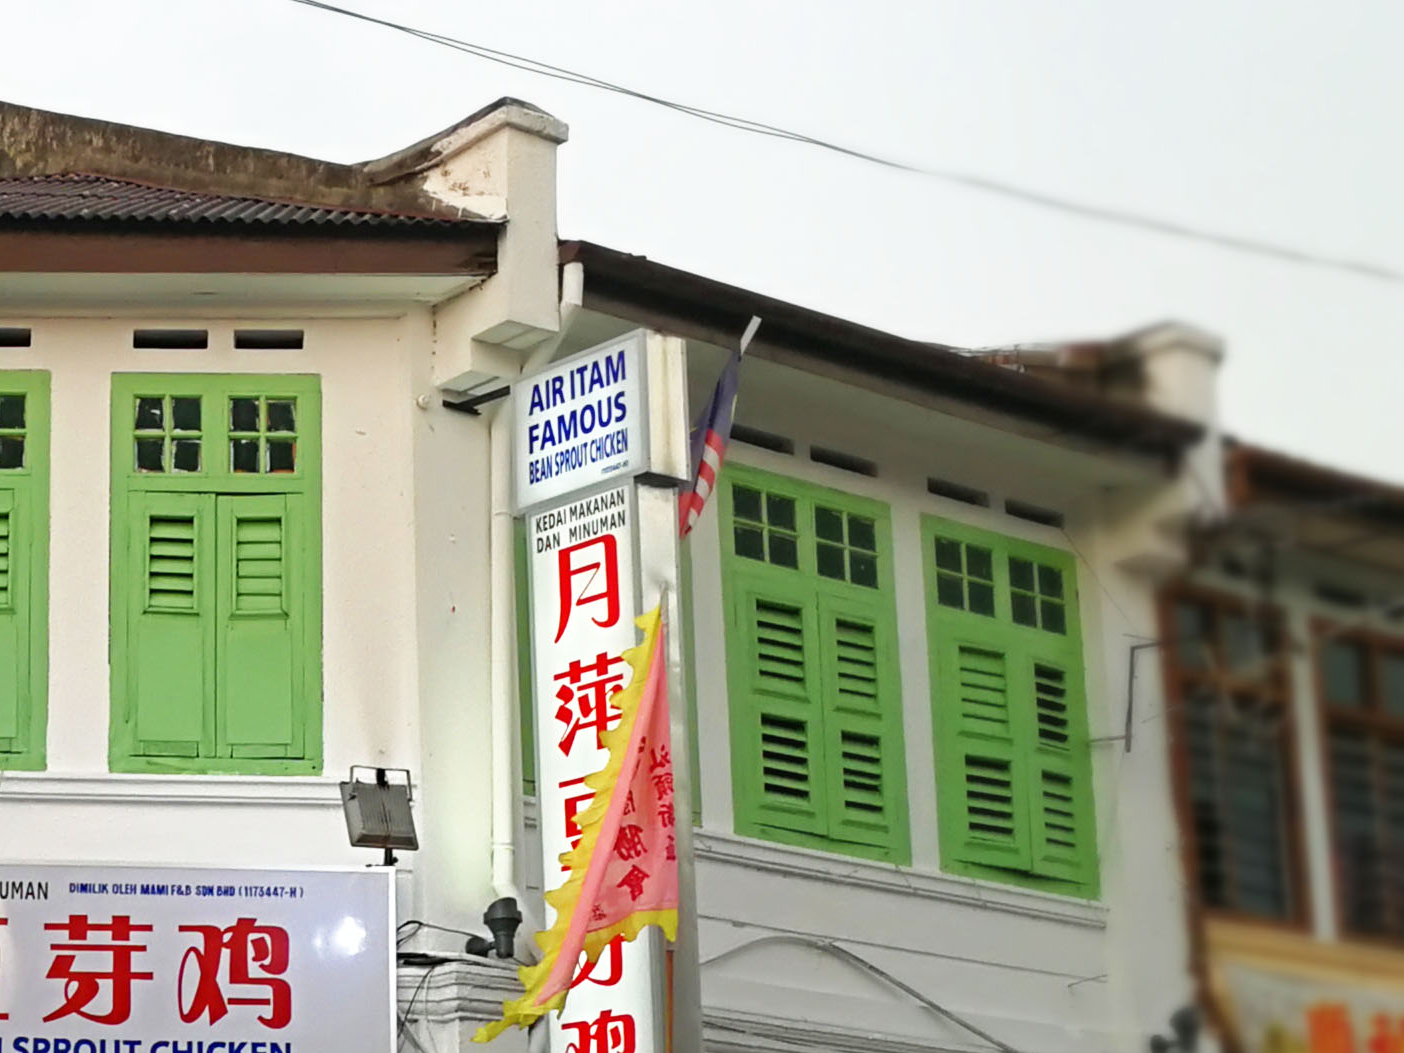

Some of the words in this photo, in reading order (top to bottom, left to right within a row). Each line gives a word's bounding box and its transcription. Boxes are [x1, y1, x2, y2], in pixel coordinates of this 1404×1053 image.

[529, 375, 565, 416] AIR
[570, 350, 626, 400] ITAM
[528, 390, 627, 455] FAMOUS
[529, 454, 553, 485] BEAN
[554, 442, 588, 477] SPROUT
[590, 428, 629, 464] CHICKEN
[536, 508, 567, 534] KEDAI
[570, 488, 626, 523] MAKANAN
[536, 531, 561, 554] DAN
[568, 510, 627, 544] MINUMAN
[69, 882, 109, 895] DIMILIK
[112, 883, 137, 895] OLEH
[140, 884, 169, 896] MAMI
[171, 884, 192, 896] F&B
[195, 885, 214, 897] SDN
[216, 886, 235, 897] BHD
